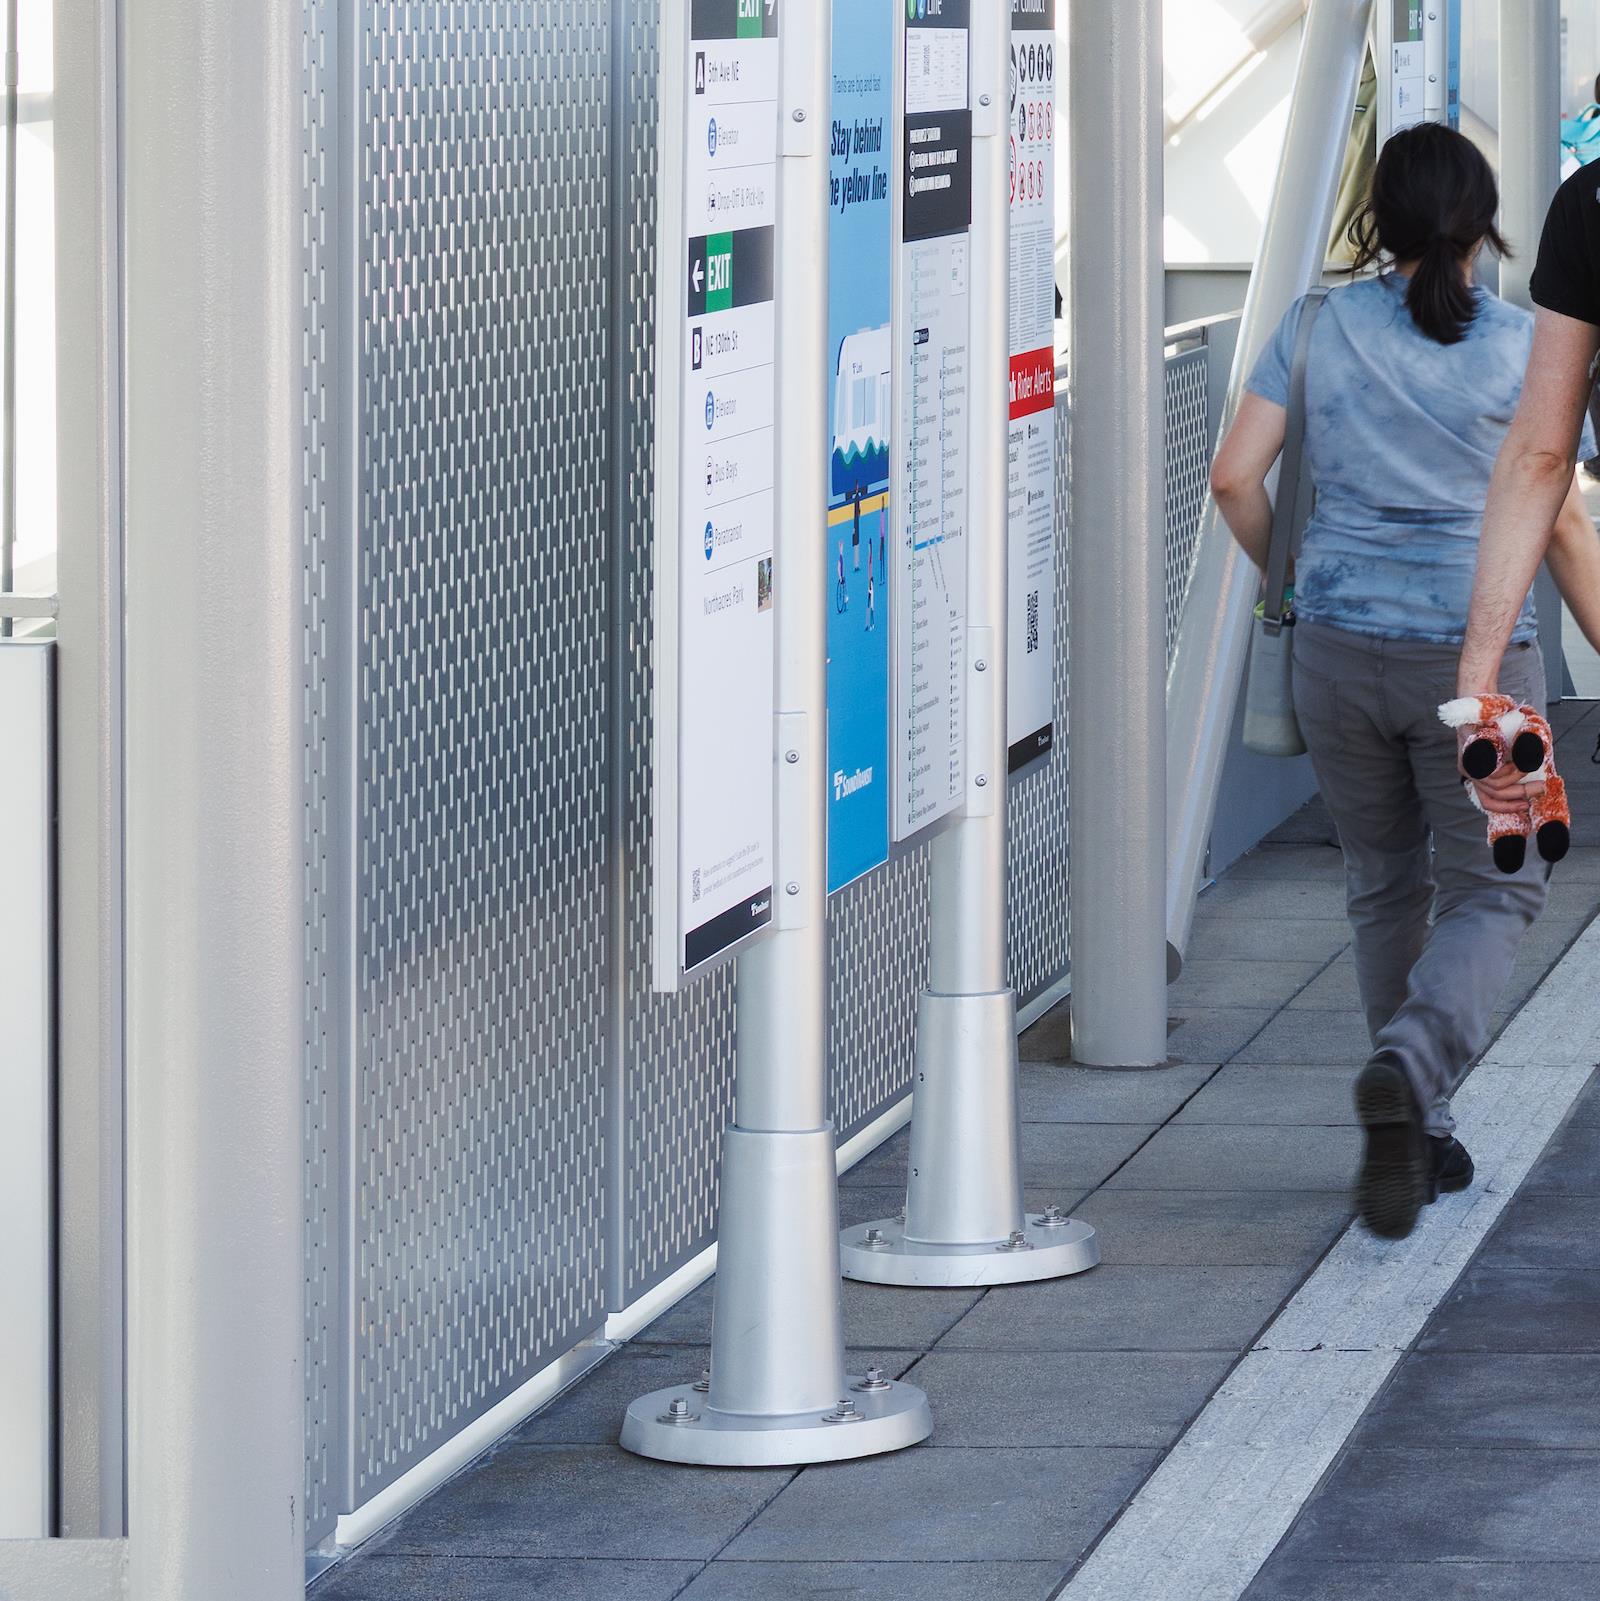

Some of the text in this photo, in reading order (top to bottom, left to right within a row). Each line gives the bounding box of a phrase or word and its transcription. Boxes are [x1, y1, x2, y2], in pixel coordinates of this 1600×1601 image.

[719, 60, 730, 82] Ave
[830, 120, 852, 165] Stay
[853, 116, 883, 155] behind
[830, 169, 840, 206] he
[840, 167, 871, 215] yellow
[871, 165, 887, 201] line
[707, 253, 732, 292] EXIT
[1017, 368, 1033, 401] Rider
[1033, 364, 1052, 396] Alerts
[715, 460, 738, 484] Bus Bays
